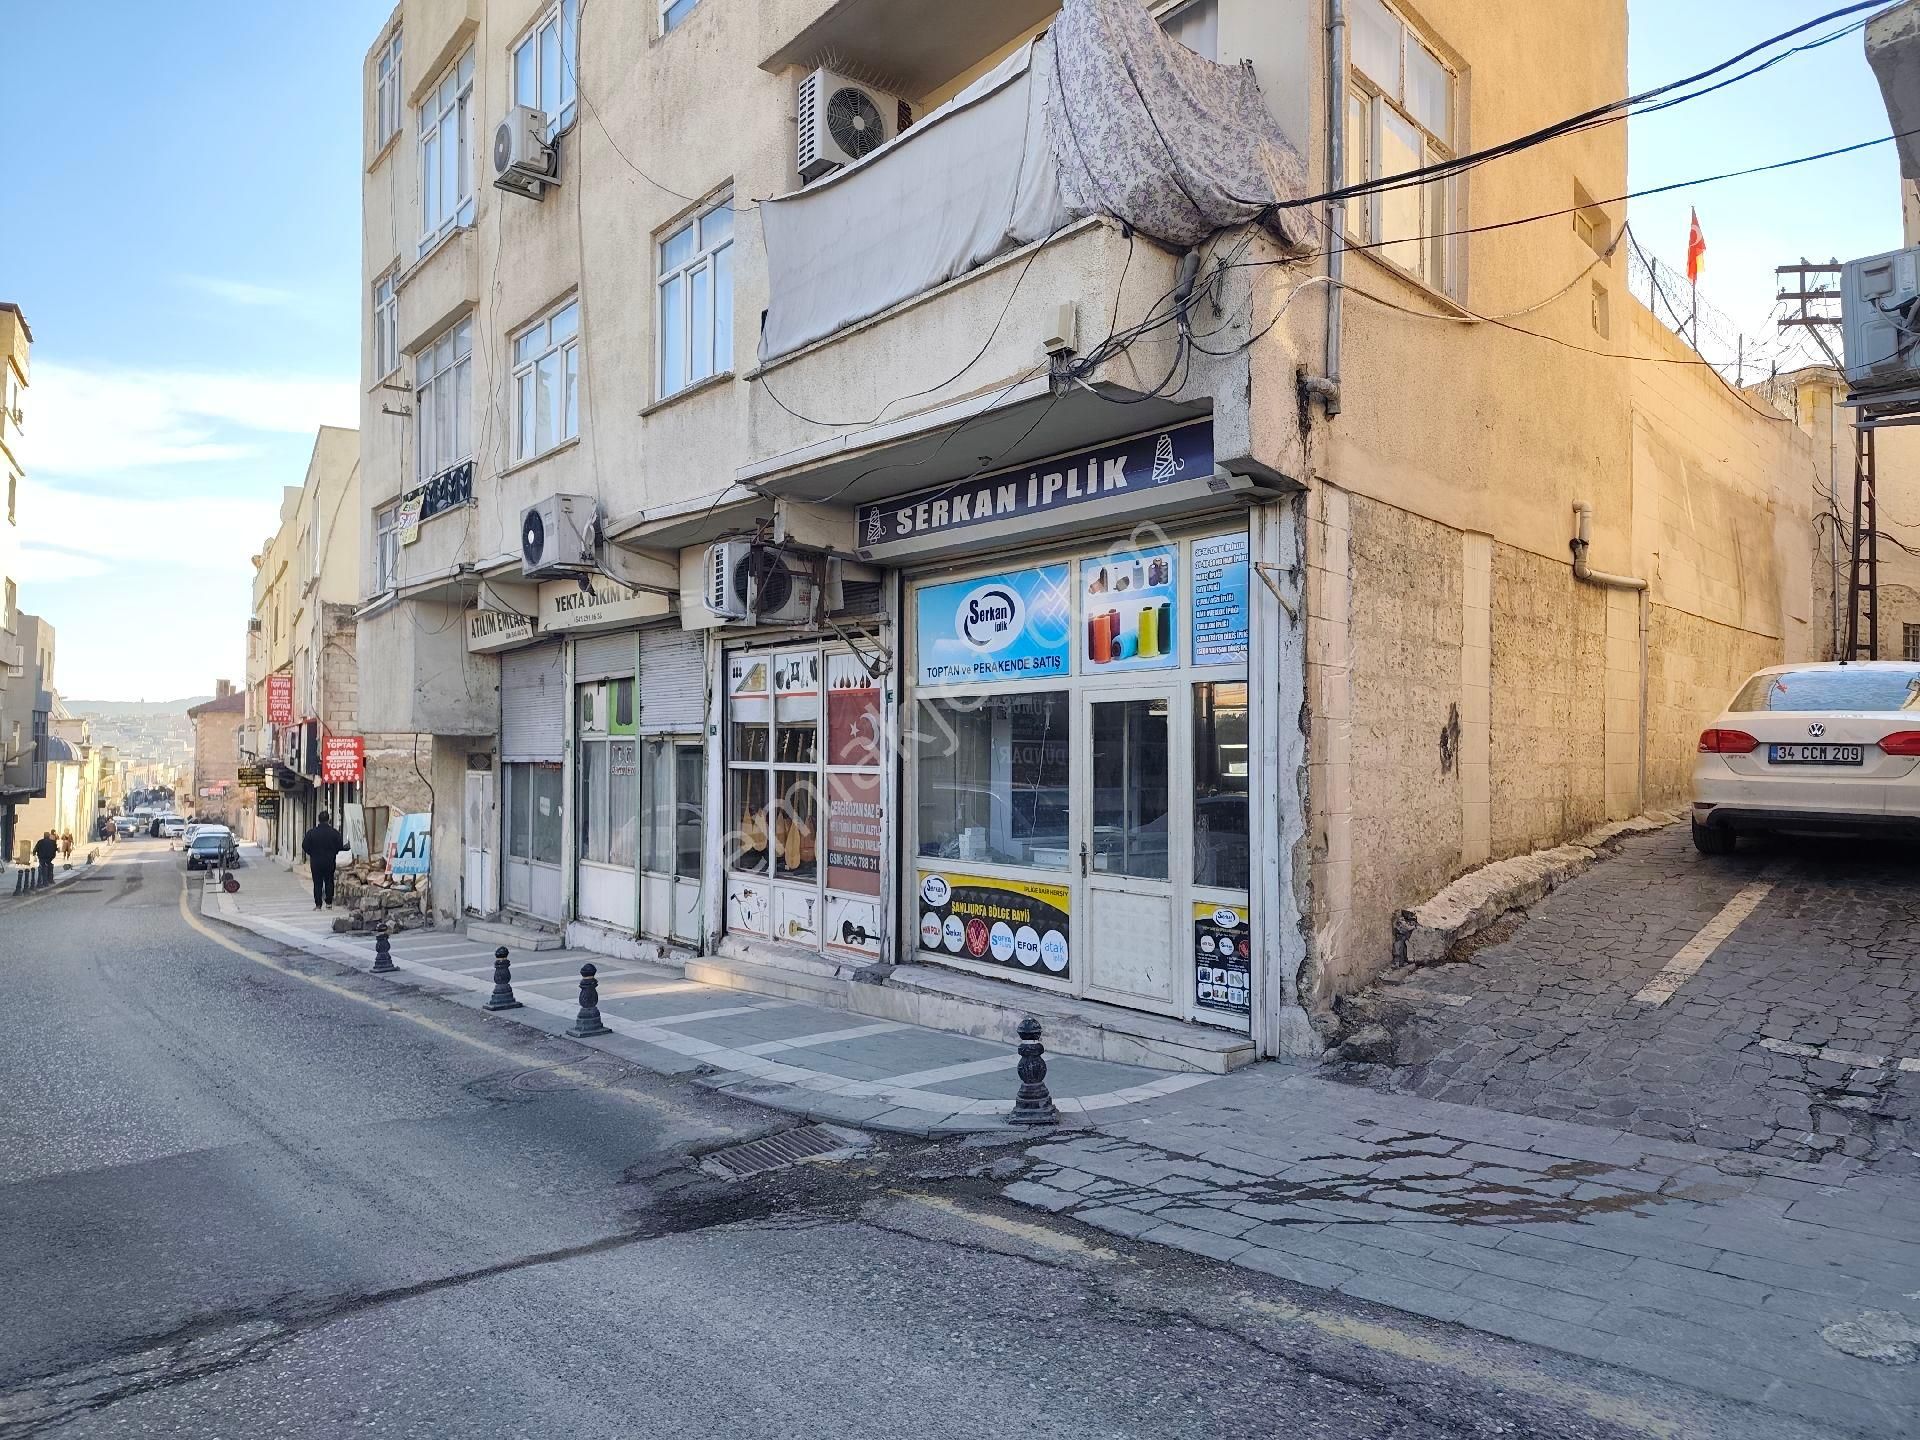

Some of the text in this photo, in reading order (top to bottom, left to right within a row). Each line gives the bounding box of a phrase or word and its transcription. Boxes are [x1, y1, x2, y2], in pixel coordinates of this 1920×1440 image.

[896, 454, 1129, 535] SERKAN İPLİK
[554, 592, 585, 613] YEKTA
[969, 599, 1008, 624] Serkan
[471, 612, 497, 639] ATILIM
[926, 654, 1061, 678] TOPTAN ve PERAKENDE SATIŞ
[1778, 746, 1795, 759] 34
[1832, 747, 1859, 761] 209
[326, 762, 358, 770] TOPTAN
[329, 769, 354, 777] ÇEYİZ
[843, 854, 858, 867] 0542
[951, 900, 987, 917] ŞANLIURFA
[988, 904, 1010, 920] BÖLGE
[1017, 940, 1038, 952] EFOR
[1044, 941, 1065, 953] atak
